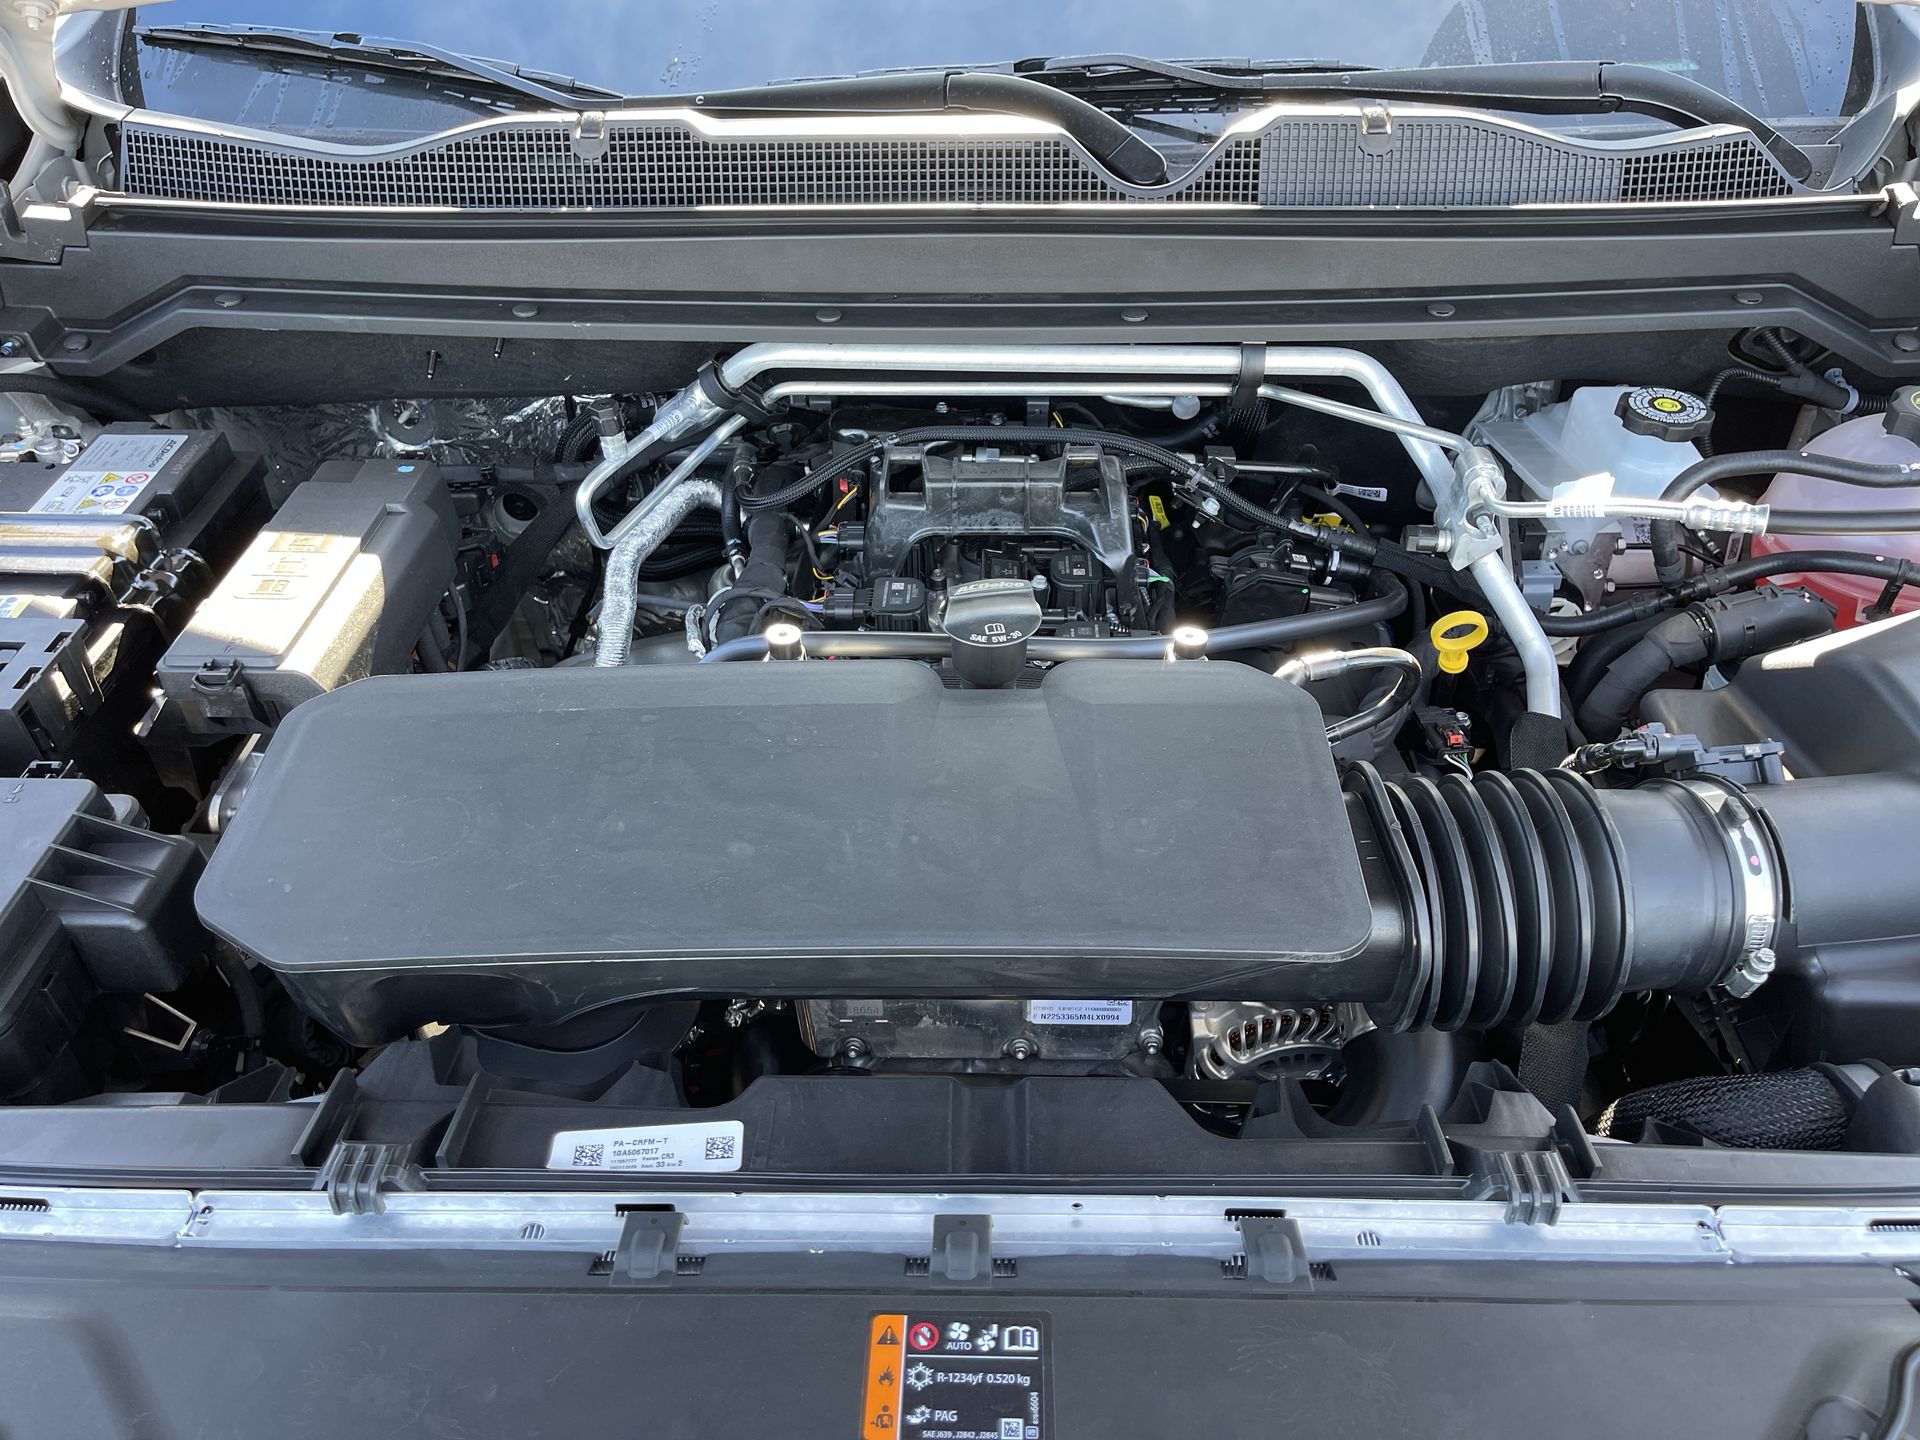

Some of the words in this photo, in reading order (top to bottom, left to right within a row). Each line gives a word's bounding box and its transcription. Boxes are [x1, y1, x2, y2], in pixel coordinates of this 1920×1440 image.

[148, 439, 177, 468] ACDelco
[953, 581, 1025, 596] ACDelco
[970, 633, 988, 643] SAE
[991, 630, 1023, 643] 5W-30
[946, 1342, 972, 1350] AUTO
[937, 1373, 982, 1386] R-1234yf
[986, 1373, 1015, 1384] 0.520
[1017, 1373, 1031, 1387] kg
[935, 1410, 958, 1422] PAG
[922, 1430, 935, 1438] SAE
[979, 1431, 999, 1439] J2845
